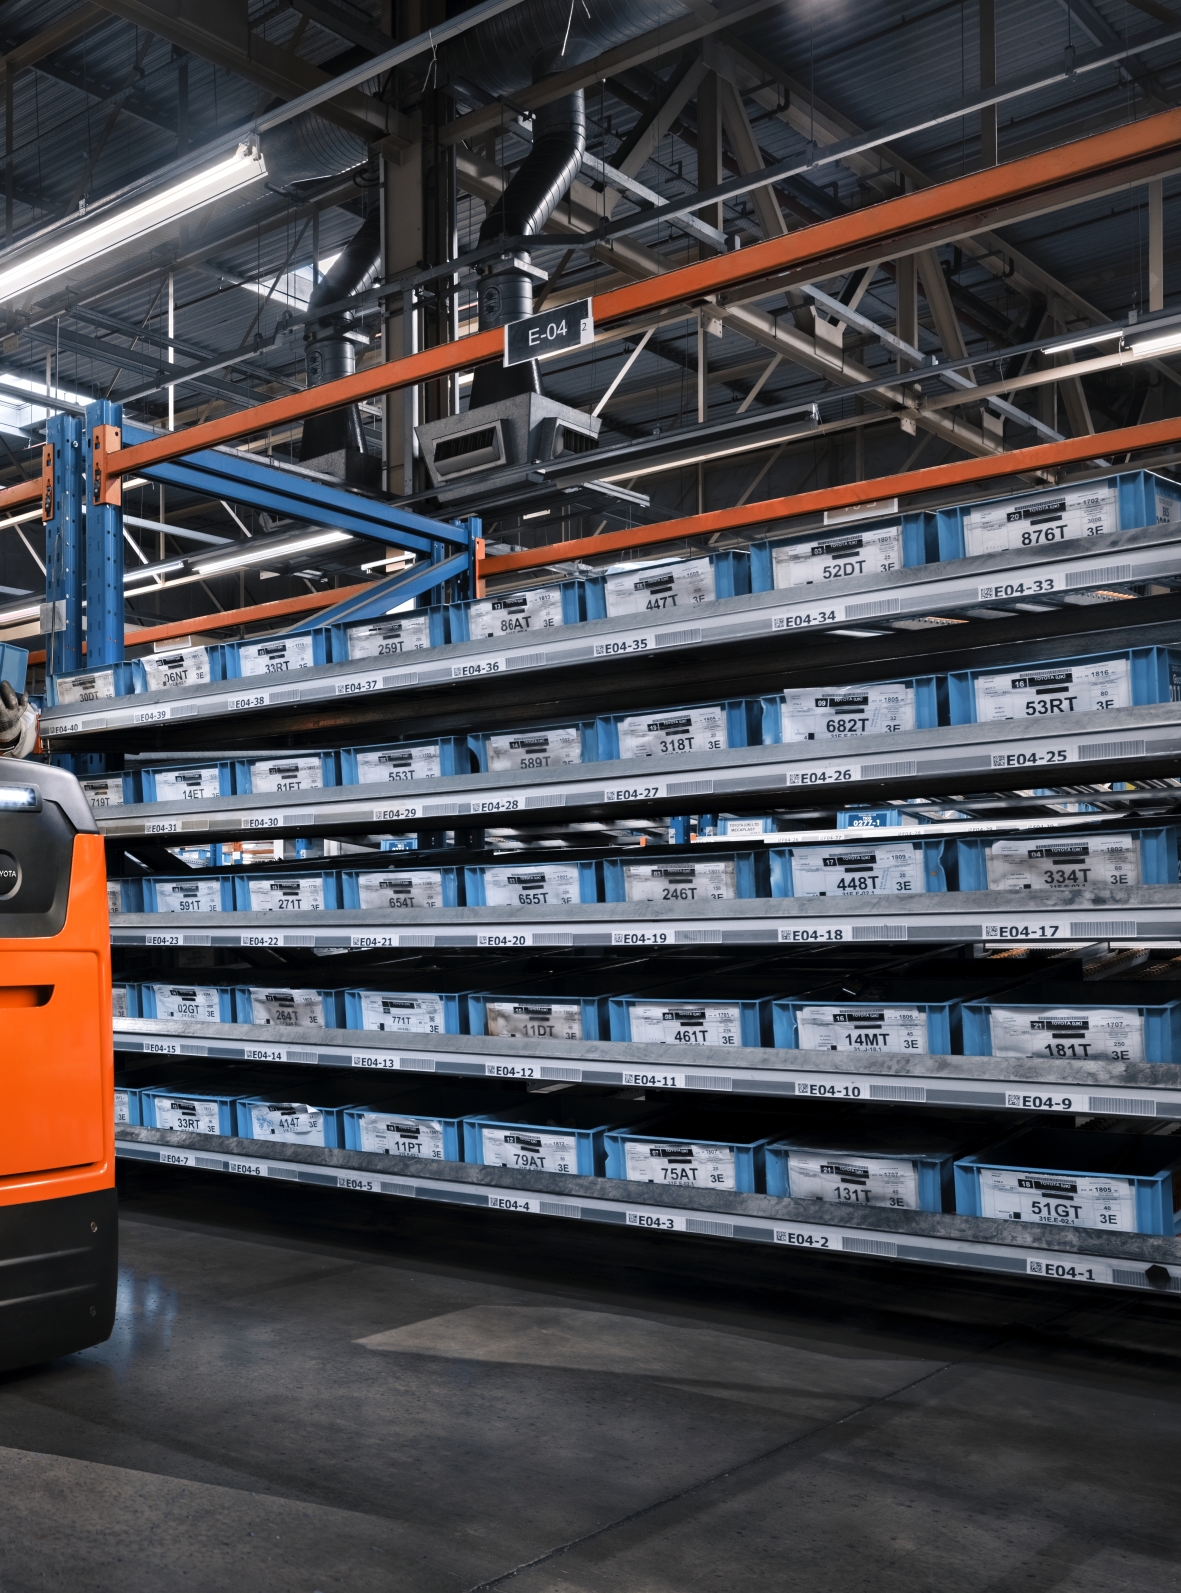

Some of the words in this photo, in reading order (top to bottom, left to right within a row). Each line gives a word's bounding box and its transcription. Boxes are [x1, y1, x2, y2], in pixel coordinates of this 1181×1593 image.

[582, 323, 587, 331] 2
[529, 320, 567, 346] E-04
[1083, 497, 1099, 505] 1702
[1010, 513, 1019, 521] 20
[1022, 525, 1068, 546] 876T
[823, 560, 866, 580] 52DT
[995, 579, 1054, 597] E04-33
[646, 594, 678, 611] 447T
[501, 616, 531, 632] 86AT
[543, 618, 554, 627] 3E
[786, 611, 836, 627] E04-34
[378, 641, 404, 655] 259T
[605, 639, 647, 654] E04-35
[462, 662, 499, 676] E04-36
[1091, 669, 1109, 678] 1816
[345, 680, 377, 693] E04-37
[79, 691, 98, 702] 30DT
[236, 697, 264, 708] E04-38
[1026, 697, 1077, 716] 53RT
[140, 711, 166, 722] E04-39
[55, 724, 78, 733] E04-40
[826, 718, 869, 733] 682T
[660, 737, 694, 752] 318T
[708, 740, 721, 750] 3E
[520, 757, 550, 769] 589T
[1006, 750, 1067, 766] E04-25
[389, 770, 415, 781] 553T
[801, 769, 851, 784] E04-26
[183, 789, 204, 799] 14ET
[616, 788, 658, 800] E04-27
[92, 798, 110, 807] 719T
[481, 800, 518, 811] E04-28
[383, 808, 416, 819] E04-29
[151, 824, 177, 832] E04-31
[250, 818, 278, 827] E04-30
[1044, 869, 1091, 884] 334T
[1110, 875, 1128, 885] 3E
[837, 876, 879, 891] 448T
[896, 881, 912, 891] 3E
[518, 893, 548, 904] 655T
[662, 888, 697, 900] 246T
[180, 901, 201, 910] 591T
[209, 904, 217, 912] 3E
[278, 899, 301, 909] 271T
[389, 897, 415, 908] 654T
[793, 929, 843, 941] E04-18
[1000, 925, 1059, 937] E04-17
[153, 937, 178, 945] E04-23
[250, 937, 278, 945] E04-22
[360, 937, 392, 946] E04-21
[488, 936, 525, 945] E04-20
[623, 933, 667, 944] E04-19
[178, 1004, 199, 1014] 02GT
[276, 1010, 299, 1021] 264T
[392, 1016, 411, 1024] 771T
[429, 1025, 439, 1033] 3E
[523, 1024, 555, 1036] 11DT
[674, 1030, 708, 1043] 461T
[722, 1035, 735, 1045] 3E
[845, 1033, 889, 1046] 14MT
[150, 1044, 175, 1053] E04-15
[903, 1040, 919, 1049] 3E
[1044, 1043, 1091, 1057] 181T
[253, 1050, 281, 1060] E04-14
[1111, 1050, 1130, 1061] 3E
[361, 1058, 394, 1068] E04-13
[496, 1066, 534, 1077] E04-12
[634, 1075, 677, 1086] E04-11
[810, 1085, 860, 1097] E04-10
[1022, 1096, 1072, 1110] E04-9
[177, 1118, 200, 1129] 33RT
[279, 1117, 300, 1128] 414T
[309, 1120, 318, 1128] 3E
[394, 1141, 422, 1153] 11PT
[167, 1154, 188, 1164] E04-7
[432, 1150, 441, 1158] 3E
[513, 1154, 546, 1168] 79AT
[237, 1164, 260, 1175] E04-6
[557, 1163, 569, 1172] 3E
[661, 1168, 698, 1181] 75AT
[710, 1174, 725, 1183] 3E
[346, 1179, 372, 1190] E04-5
[834, 1186, 872, 1202] 131T
[499, 1199, 529, 1211] E04-4
[889, 1197, 905, 1207] 3E
[1031, 1201, 1082, 1219] 51GT
[639, 1216, 674, 1229] E04-3
[1099, 1214, 1118, 1225] 3E
[788, 1233, 828, 1248] E04-2
[1045, 1264, 1095, 1281] E04-1
